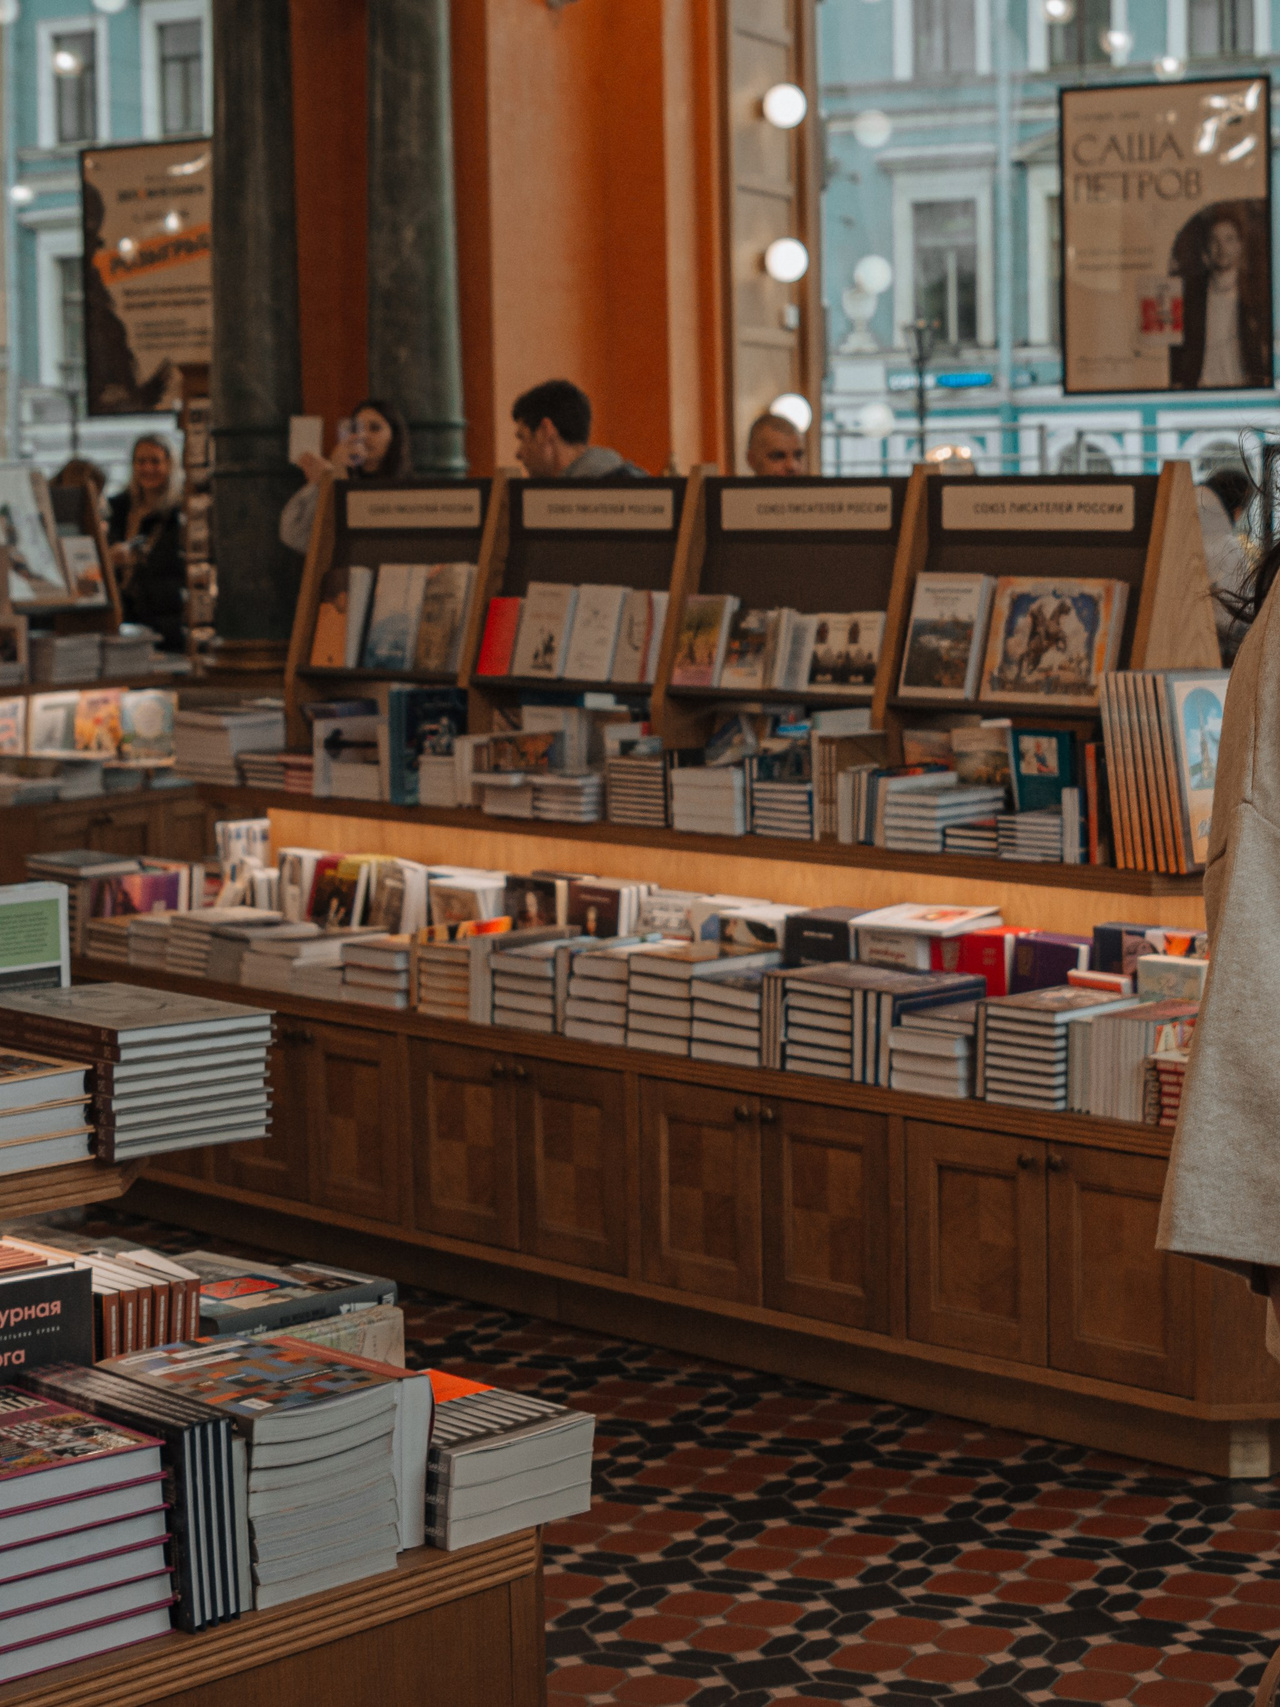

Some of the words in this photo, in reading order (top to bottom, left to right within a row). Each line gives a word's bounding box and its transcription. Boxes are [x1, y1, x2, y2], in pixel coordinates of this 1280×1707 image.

[1073, 133, 1184, 166] САША
[1074, 167, 1202, 203] ПЕТРОВ
[973, 502, 1006, 514] СОЮЗ
[1010, 502, 1073, 514] ПИСАТЕЛЕЙ
[1077, 502, 1123, 514] РОССИИ
[0, 1349, 26, 1368] га
